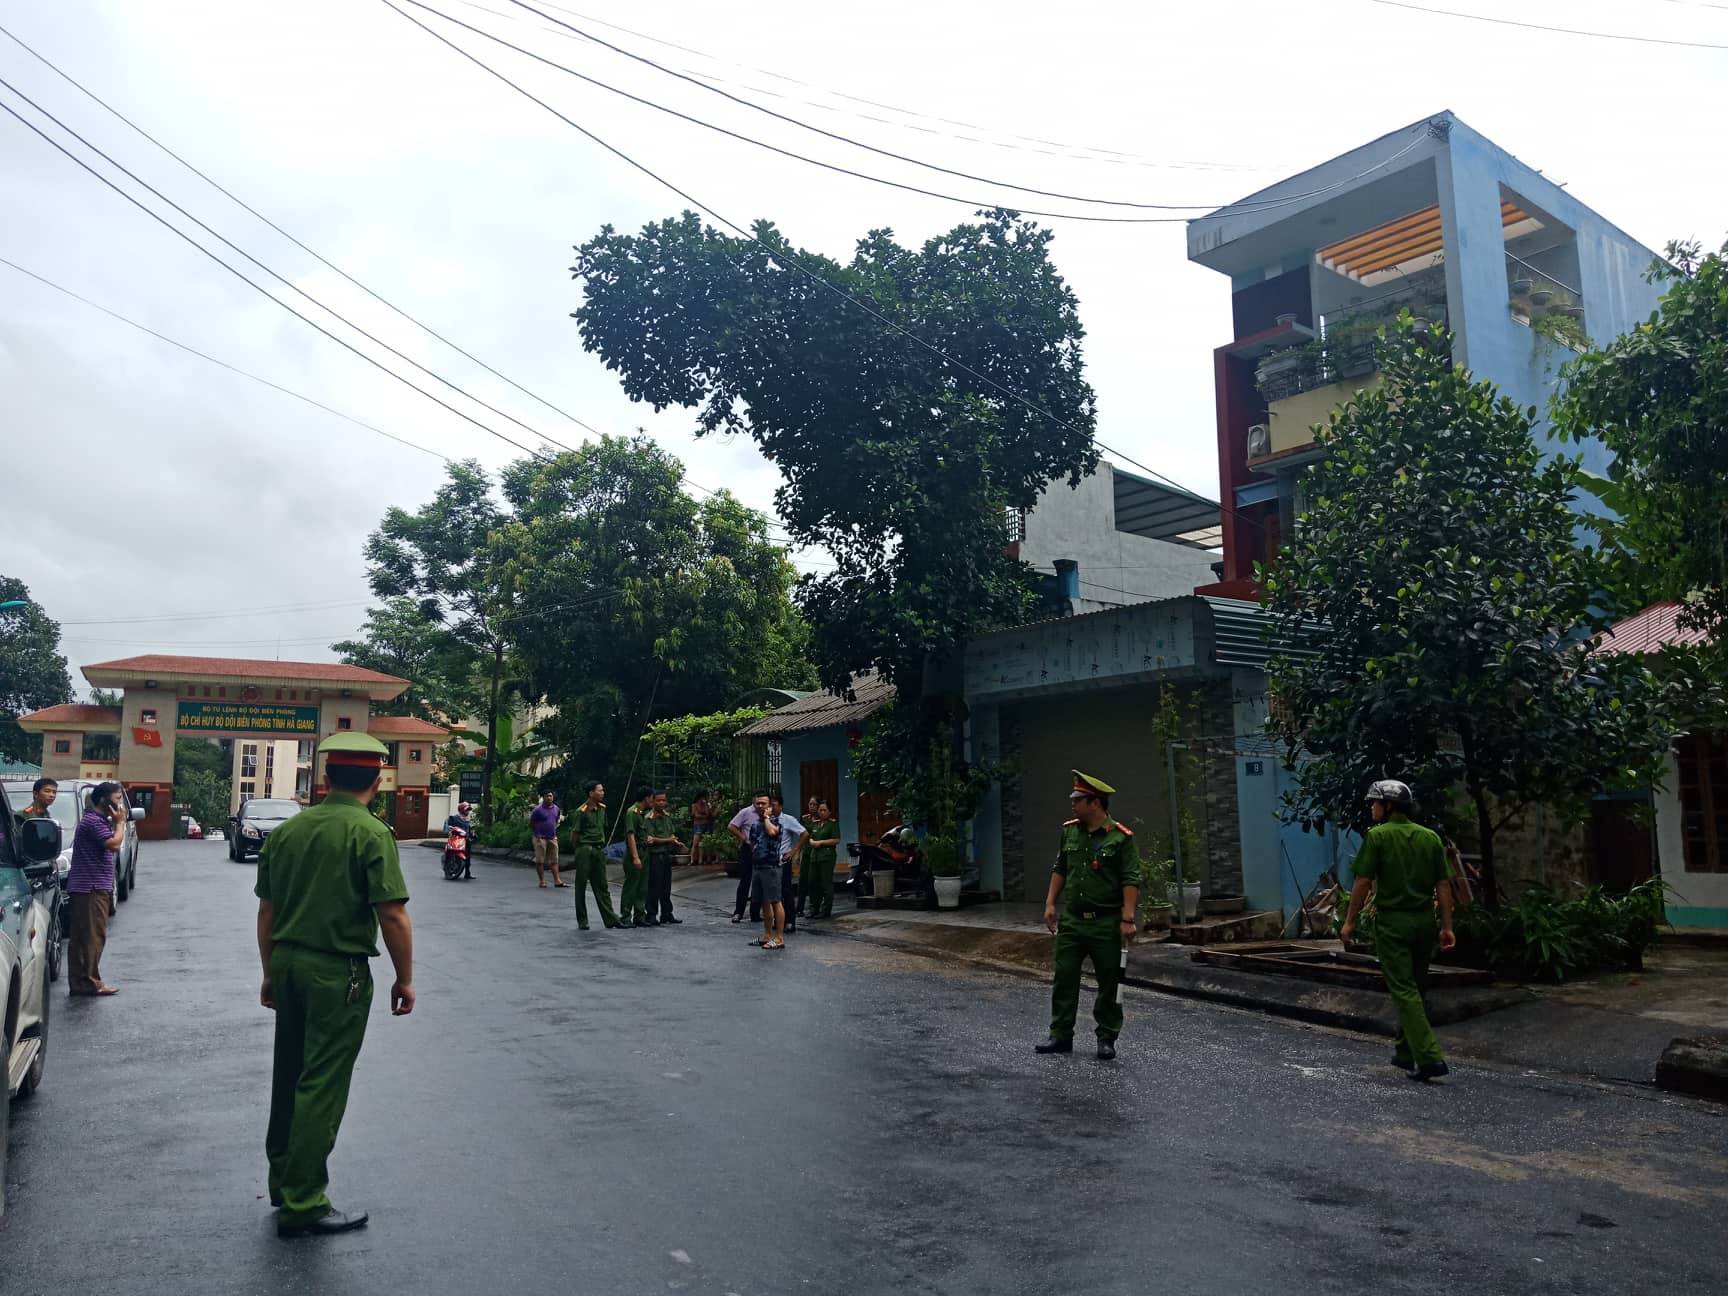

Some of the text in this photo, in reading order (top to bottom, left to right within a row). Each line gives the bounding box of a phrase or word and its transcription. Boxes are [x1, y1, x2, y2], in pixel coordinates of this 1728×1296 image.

[180, 713, 189, 727] BỘ
[202, 715, 214, 727] HUY
[216, 714, 224, 728] BỘ
[225, 714, 236, 730] ĐỘI
[251, 715, 271, 729] PHÒNG
[296, 718, 315, 730] GIANG
